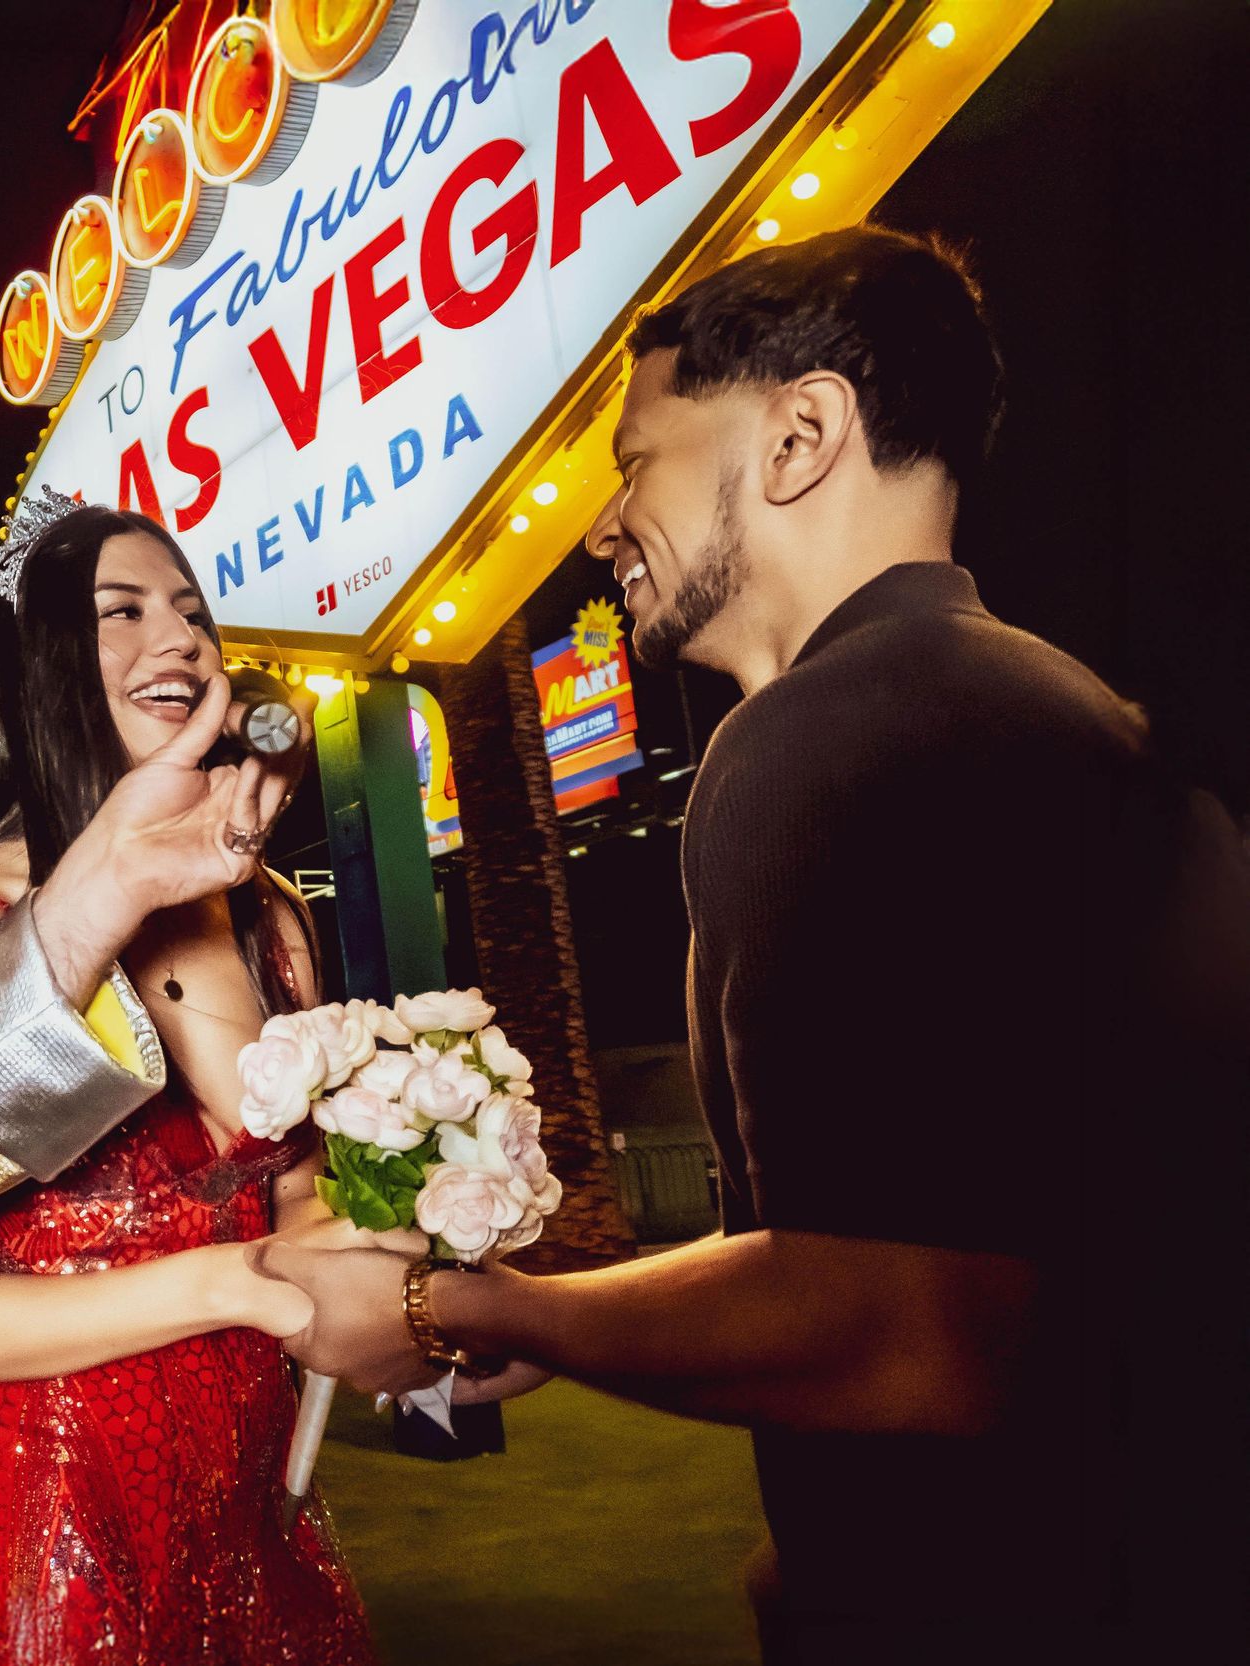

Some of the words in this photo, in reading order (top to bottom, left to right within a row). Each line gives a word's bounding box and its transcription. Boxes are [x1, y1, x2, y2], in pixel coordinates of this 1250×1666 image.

[70, 385, 223, 533] AS
[248, 0, 802, 452] VEGAS
[98, 364, 145, 434] TO
[214, 392, 485, 599] NEVADA
[342, 554, 394, 597] YESCO
[540, 659, 621, 726] MART
